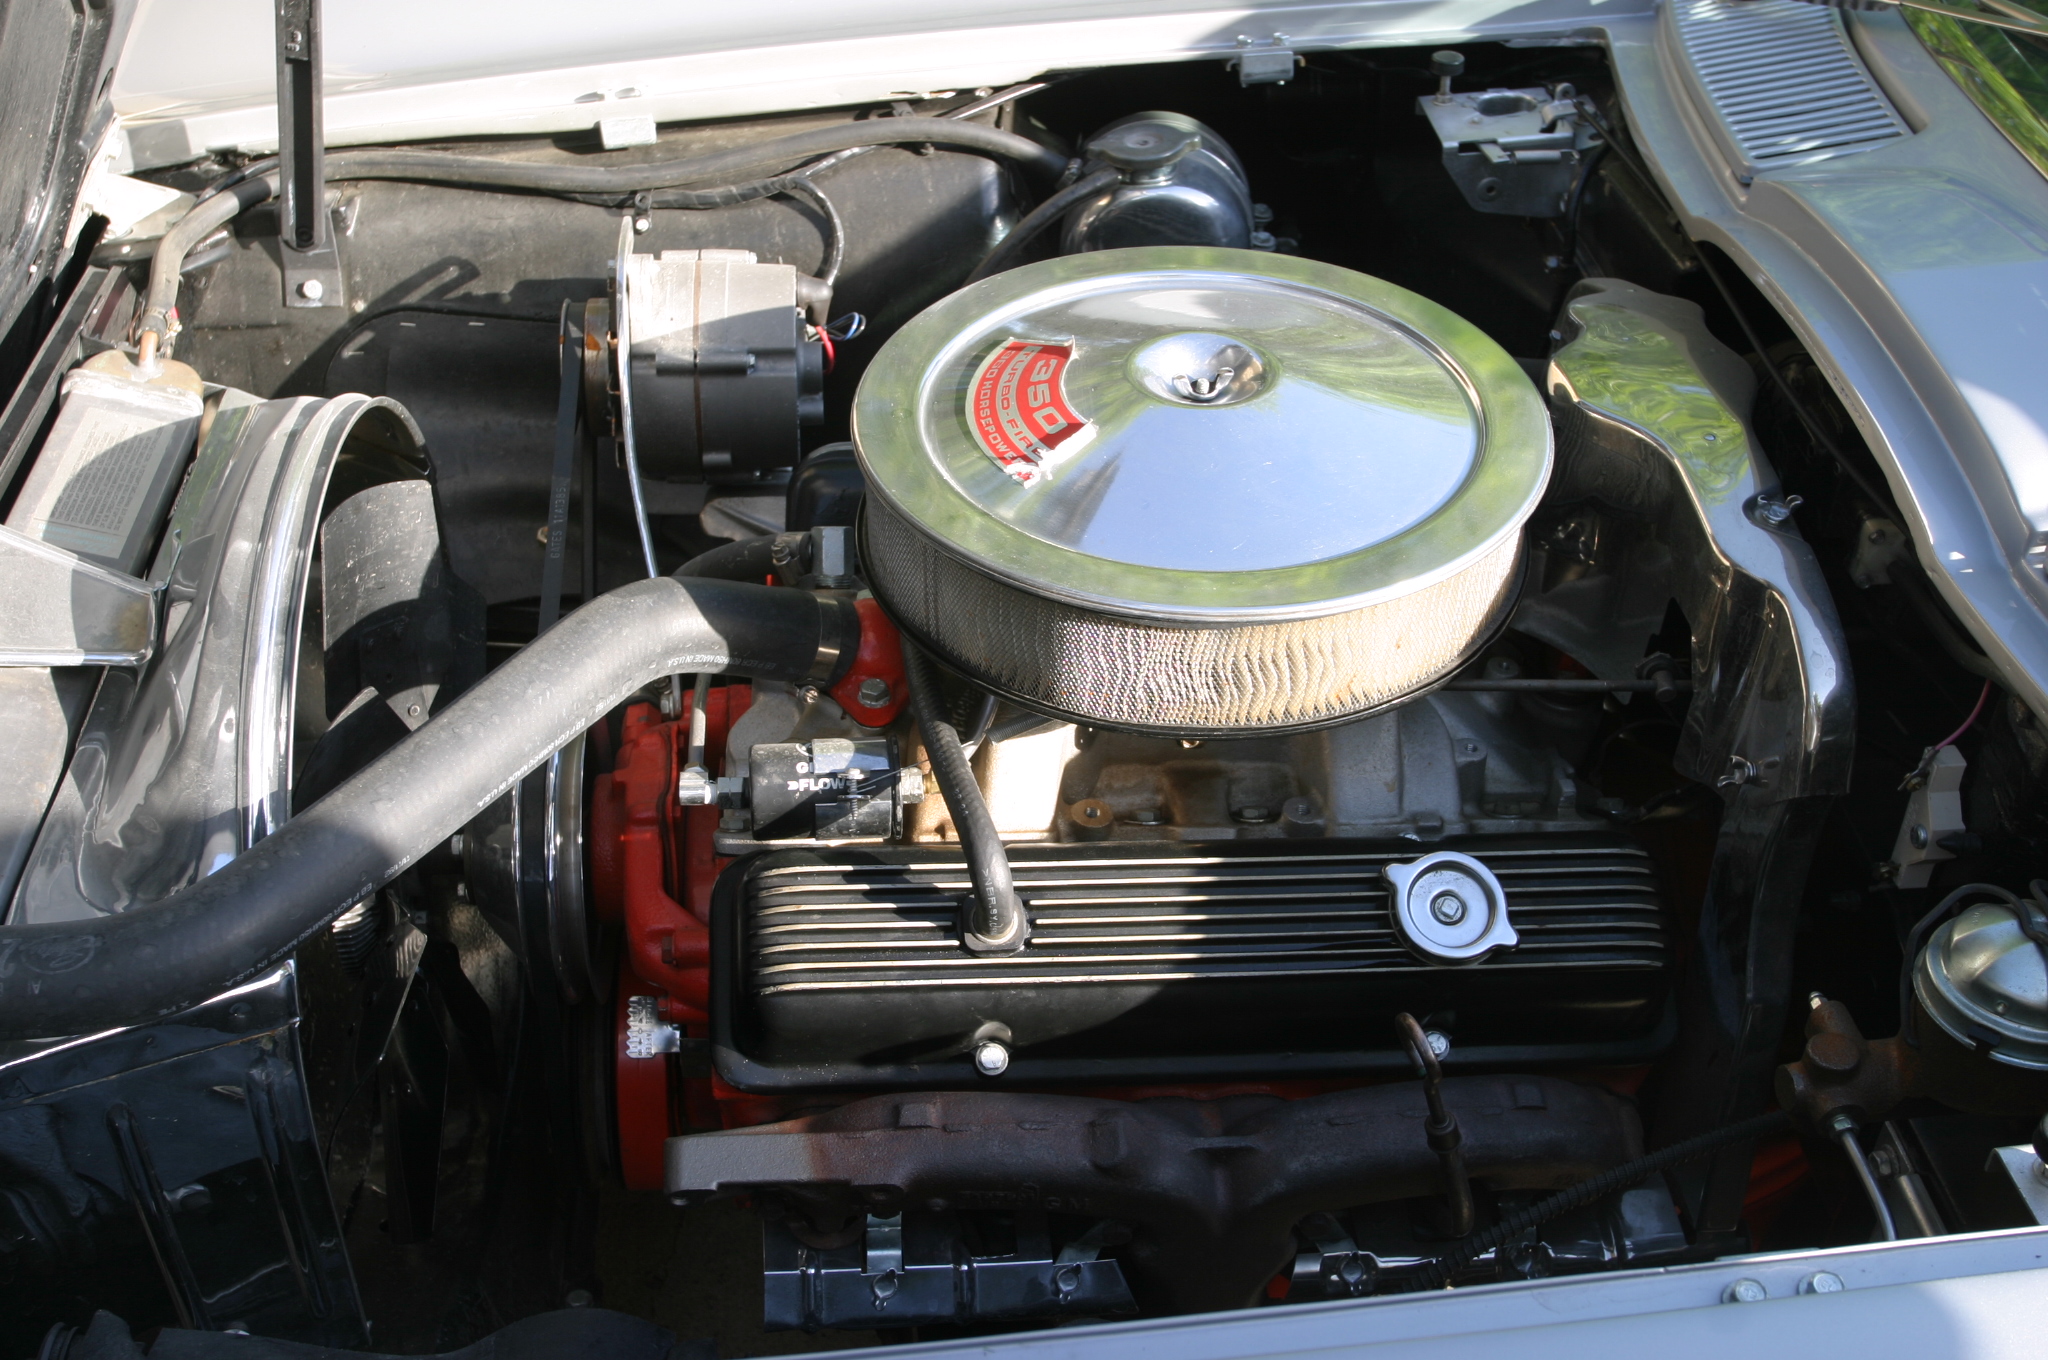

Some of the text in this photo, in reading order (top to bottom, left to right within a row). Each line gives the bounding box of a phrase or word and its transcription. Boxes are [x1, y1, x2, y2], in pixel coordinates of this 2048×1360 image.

[1027, 359, 1069, 435] 350
[550, 530, 563, 559] GATES
[694, 654, 715, 664] MADE
[798, 777, 847, 792] FLOW
[270, 938, 297, 961] MADE
[257, 959, 269, 970] IN
